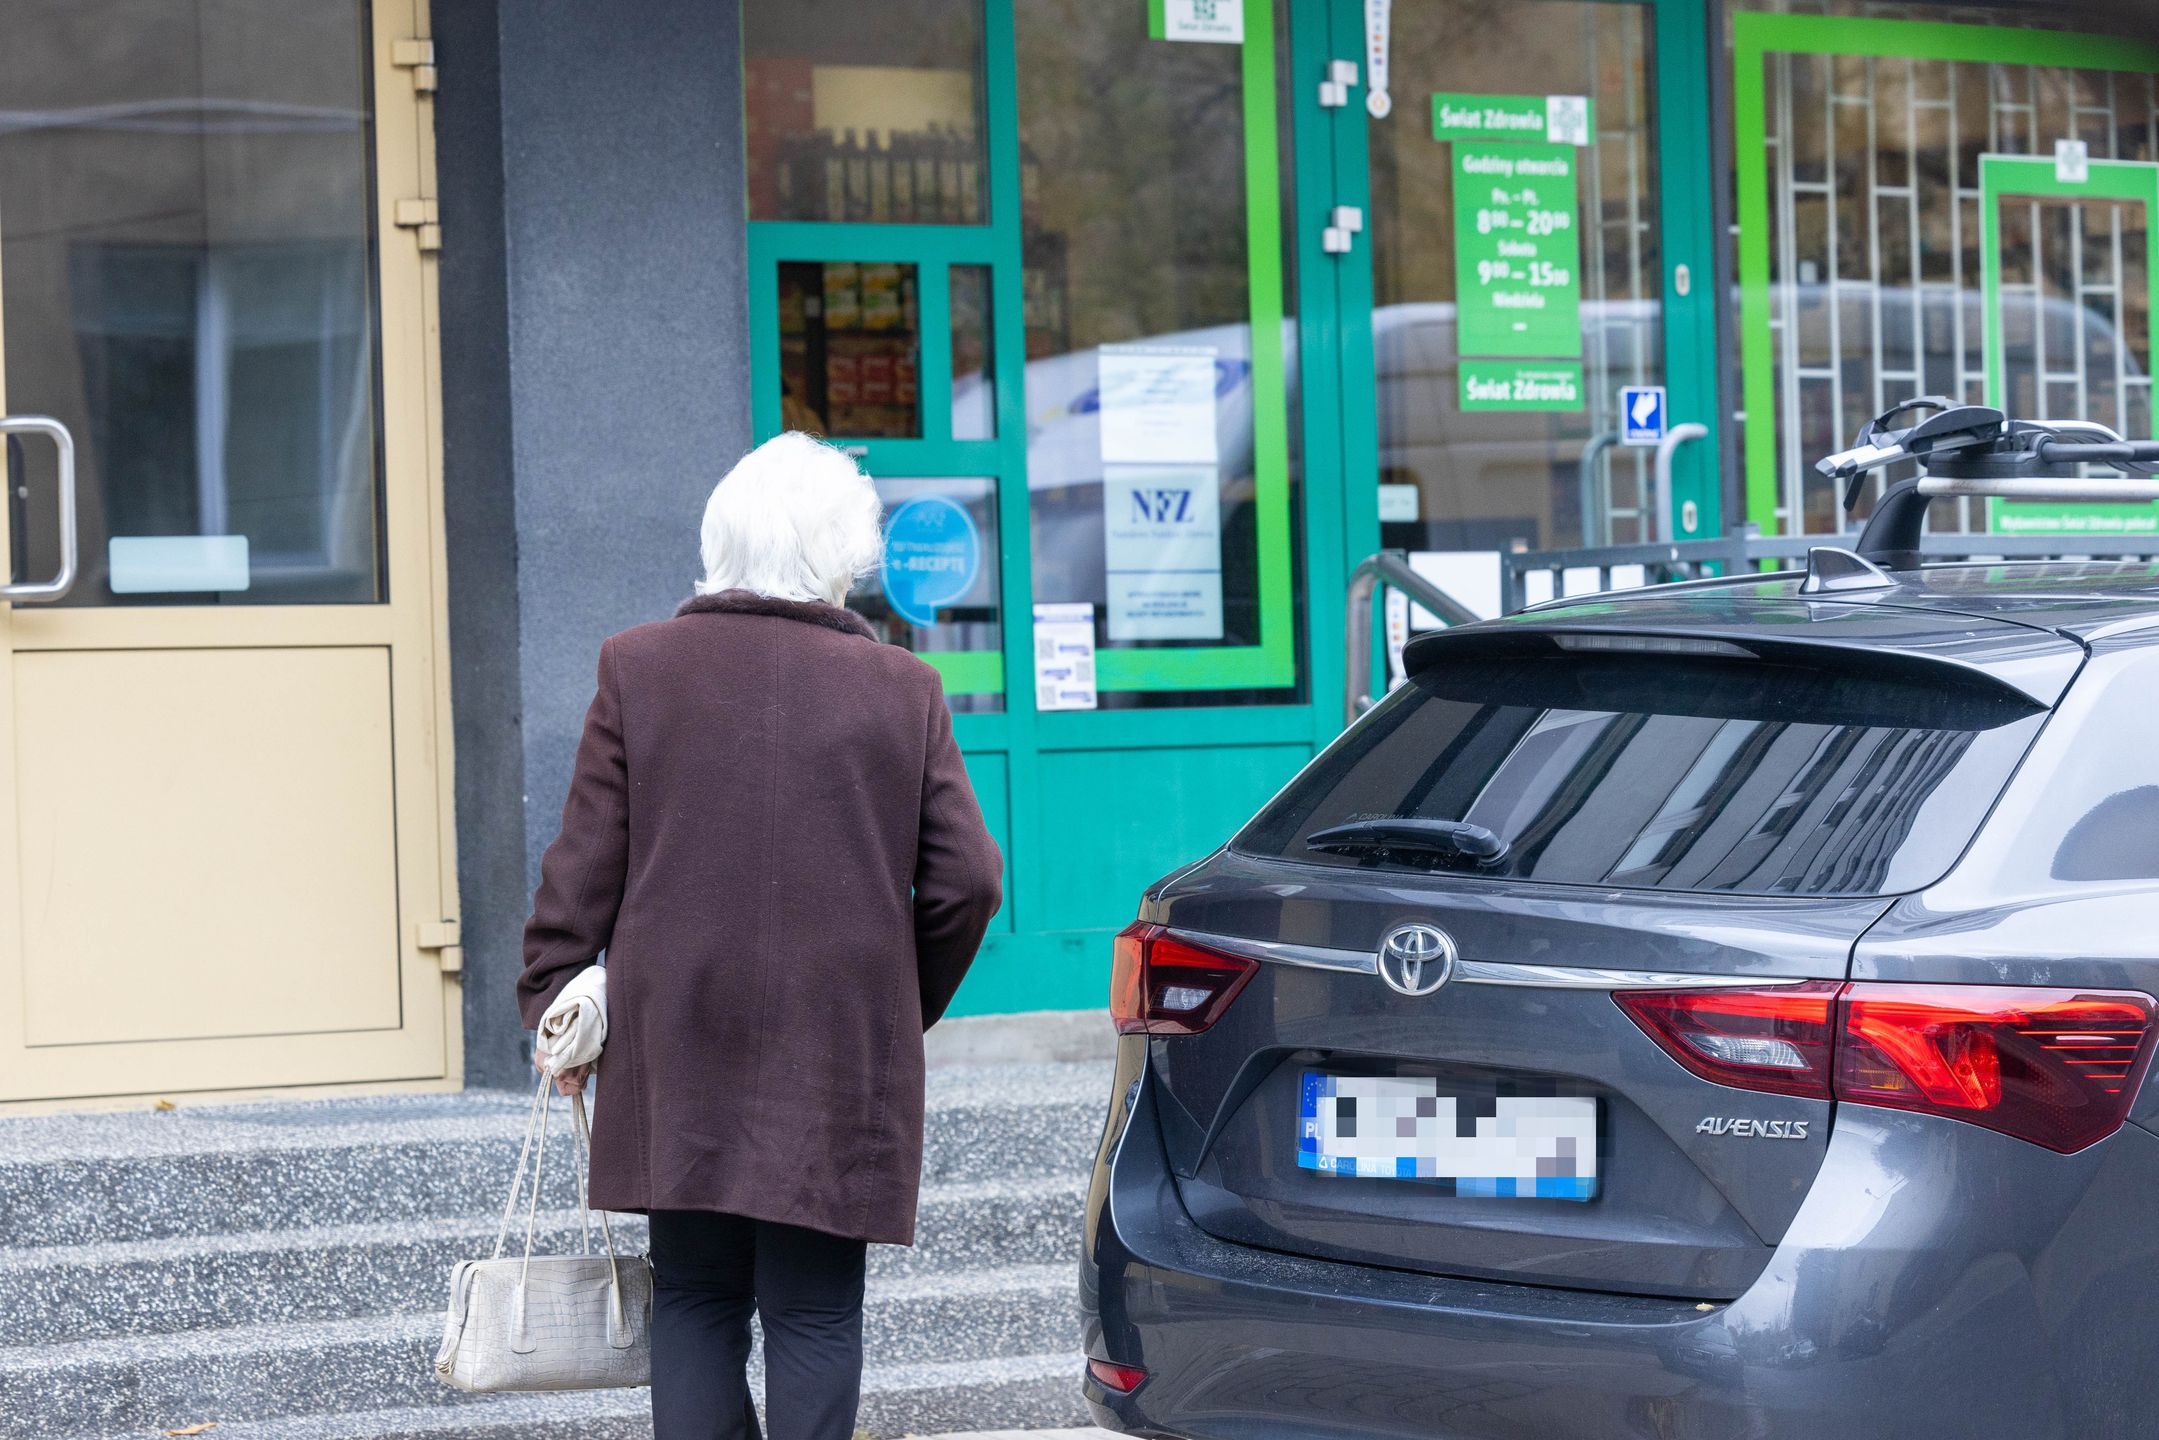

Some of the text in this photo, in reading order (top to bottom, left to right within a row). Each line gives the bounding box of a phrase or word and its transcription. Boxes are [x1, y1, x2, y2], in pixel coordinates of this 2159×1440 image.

[1440, 103, 1543, 131] Świat Zdrowia
[1462, 154, 1513, 178] Godziny
[1466, 374, 1576, 400] Świat Zdrowia
[1131, 488, 1194, 524] NFZ
[1305, 1122, 1321, 1140] PL
[1695, 1116, 1809, 1139] AVENSIS
